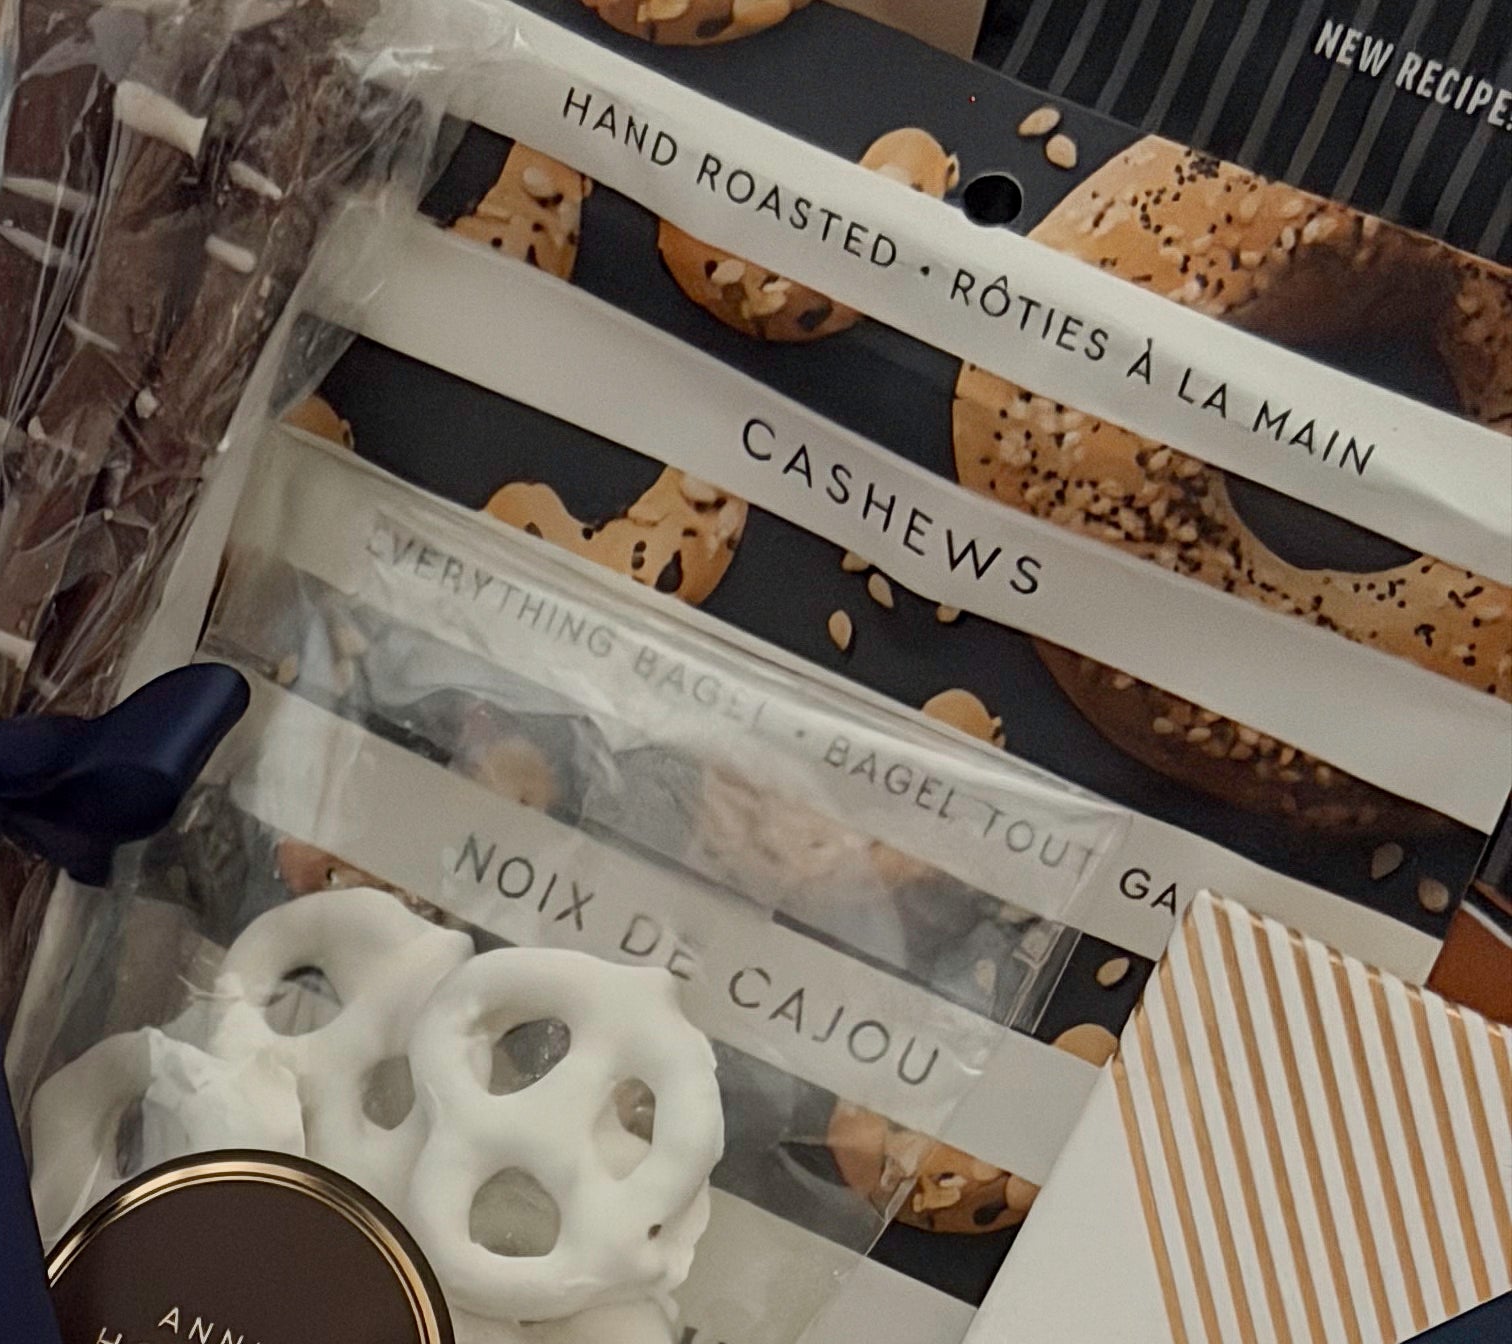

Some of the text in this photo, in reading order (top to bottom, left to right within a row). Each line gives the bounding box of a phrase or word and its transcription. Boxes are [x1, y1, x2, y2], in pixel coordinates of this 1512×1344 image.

[1314, 19, 1395, 77] NEW
[563, 86, 1378, 476] HAND ROASTED RÔTIES À LA MAIN
[742, 418, 1043, 596] CASHEWS
[823, 736, 955, 819] BAGEL
[974, 799, 1096, 877] TOUT
[1120, 867, 1180, 915] GA
[454, 833, 940, 1086] NOIX DE CAJOU
